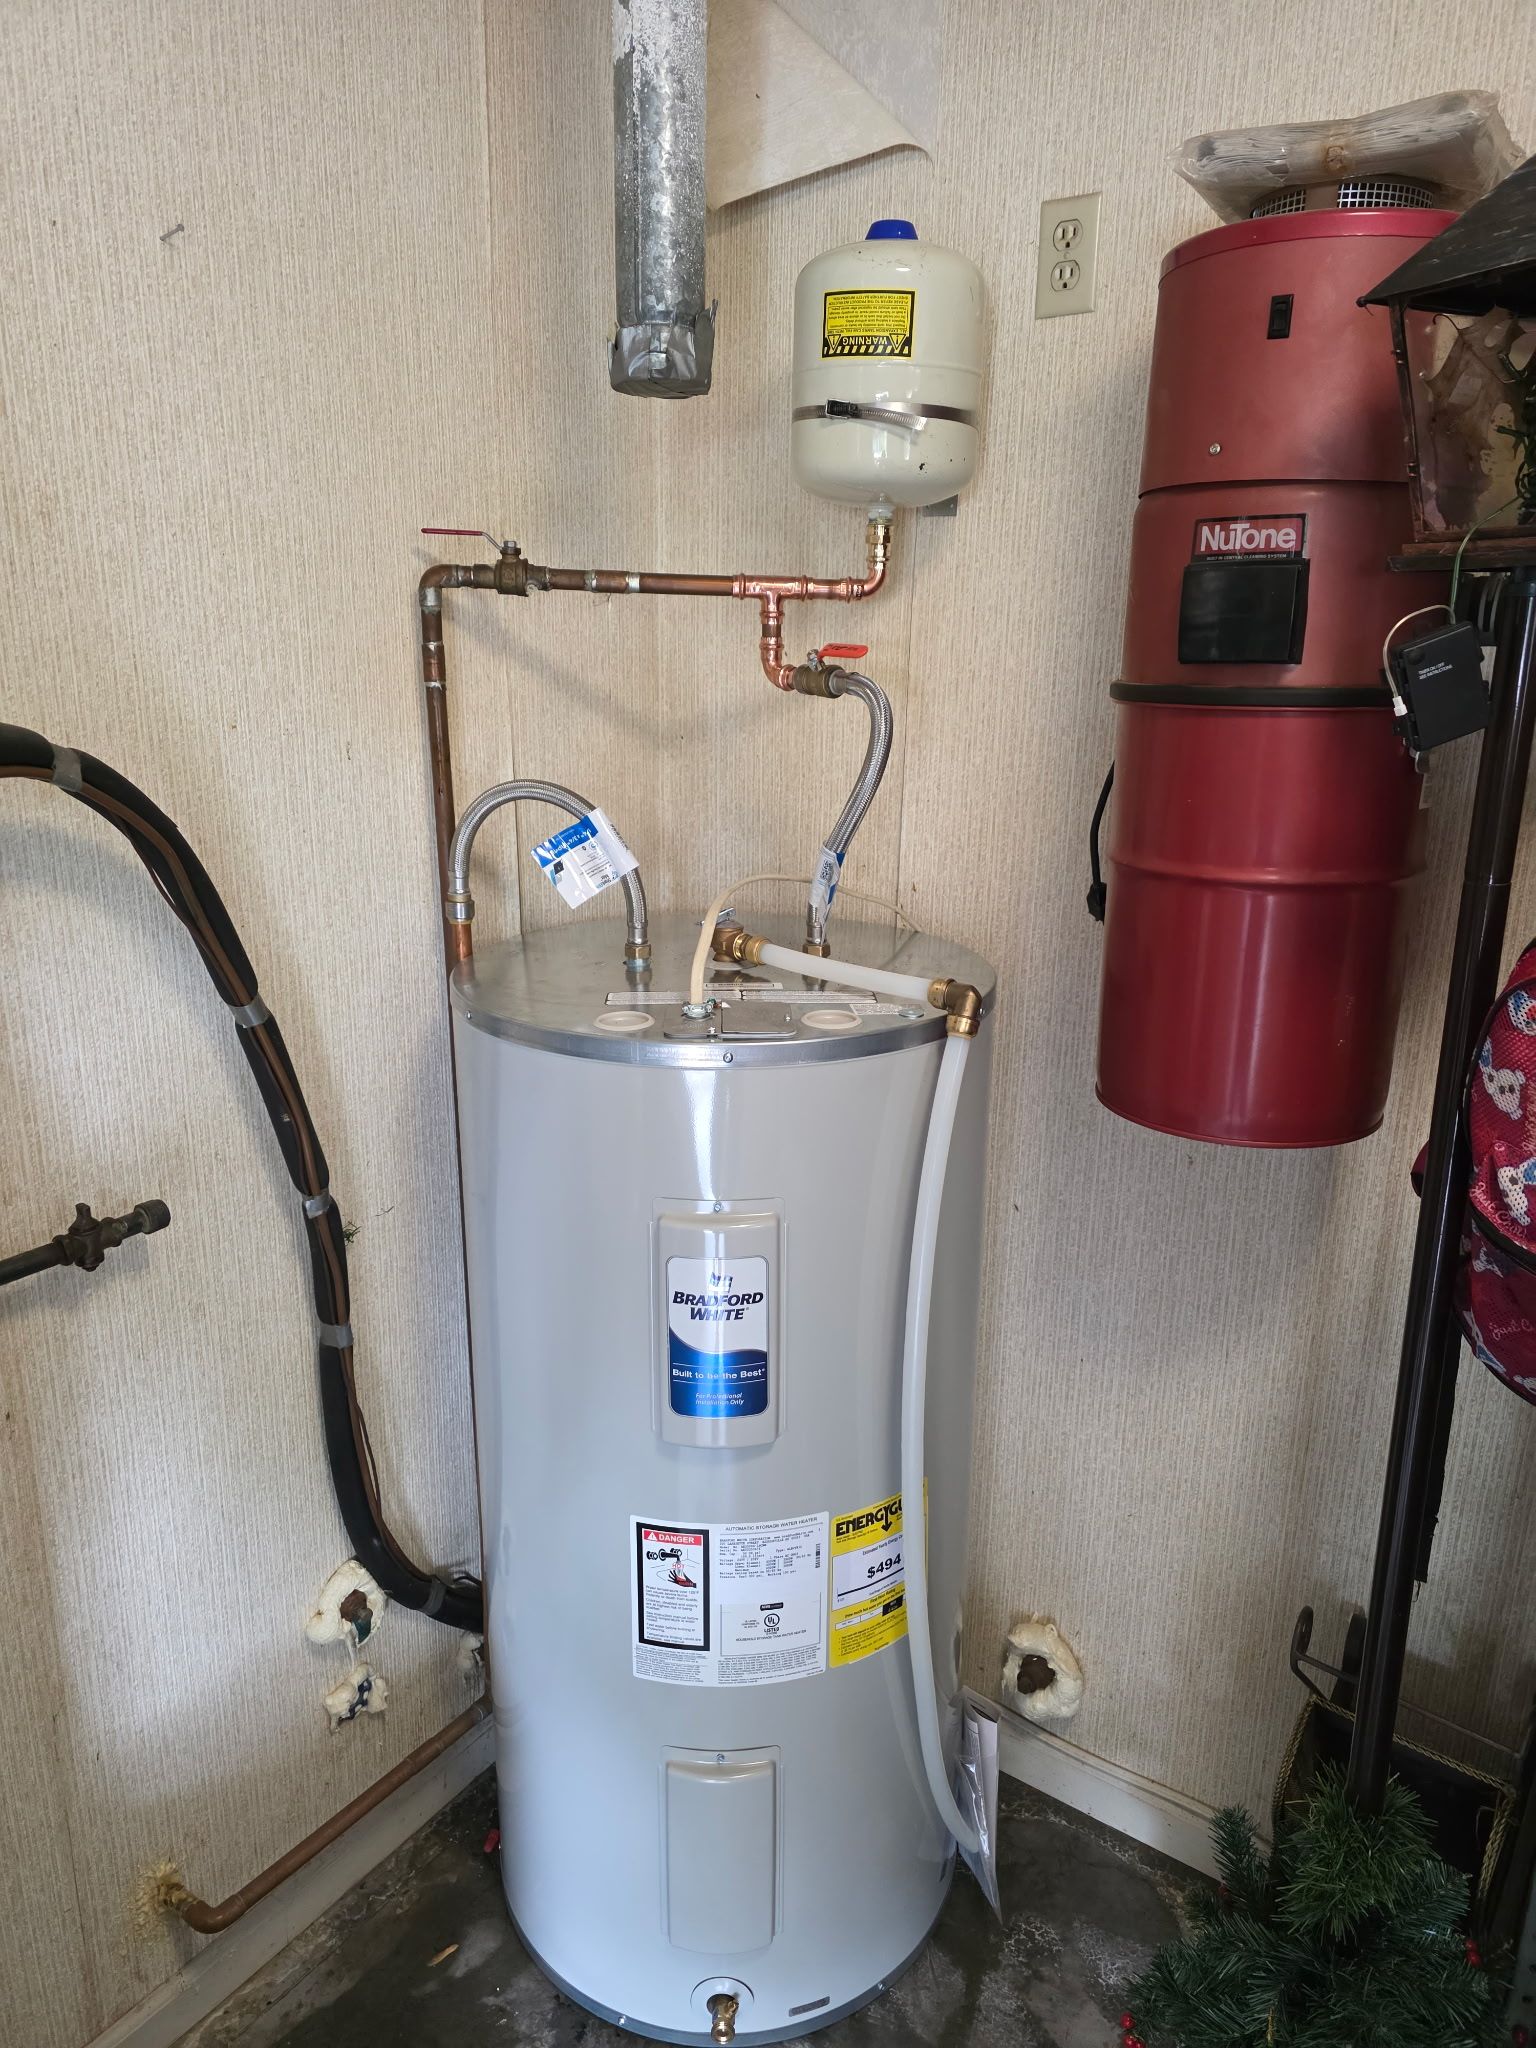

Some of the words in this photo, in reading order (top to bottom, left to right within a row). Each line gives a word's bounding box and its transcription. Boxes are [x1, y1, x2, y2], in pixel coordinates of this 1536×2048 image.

[842, 336, 888, 346] WARNING
[1200, 523, 1296, 552] NuTone
[672, 1291, 764, 1307] BRADFORD
[690, 1307, 745, 1321] WHITE
[672, 1368, 693, 1378] Built
[695, 1370, 704, 1379] to
[707, 1371, 719, 1379] be
[720, 1370, 738, 1379] the
[740, 1369, 762, 1378] Best
[798, 1516, 818, 1525] HEATER
[658, 1533, 695, 1544] DANGER
[867, 1552, 902, 1580] $494
[767, 1616, 776, 1625] UL
